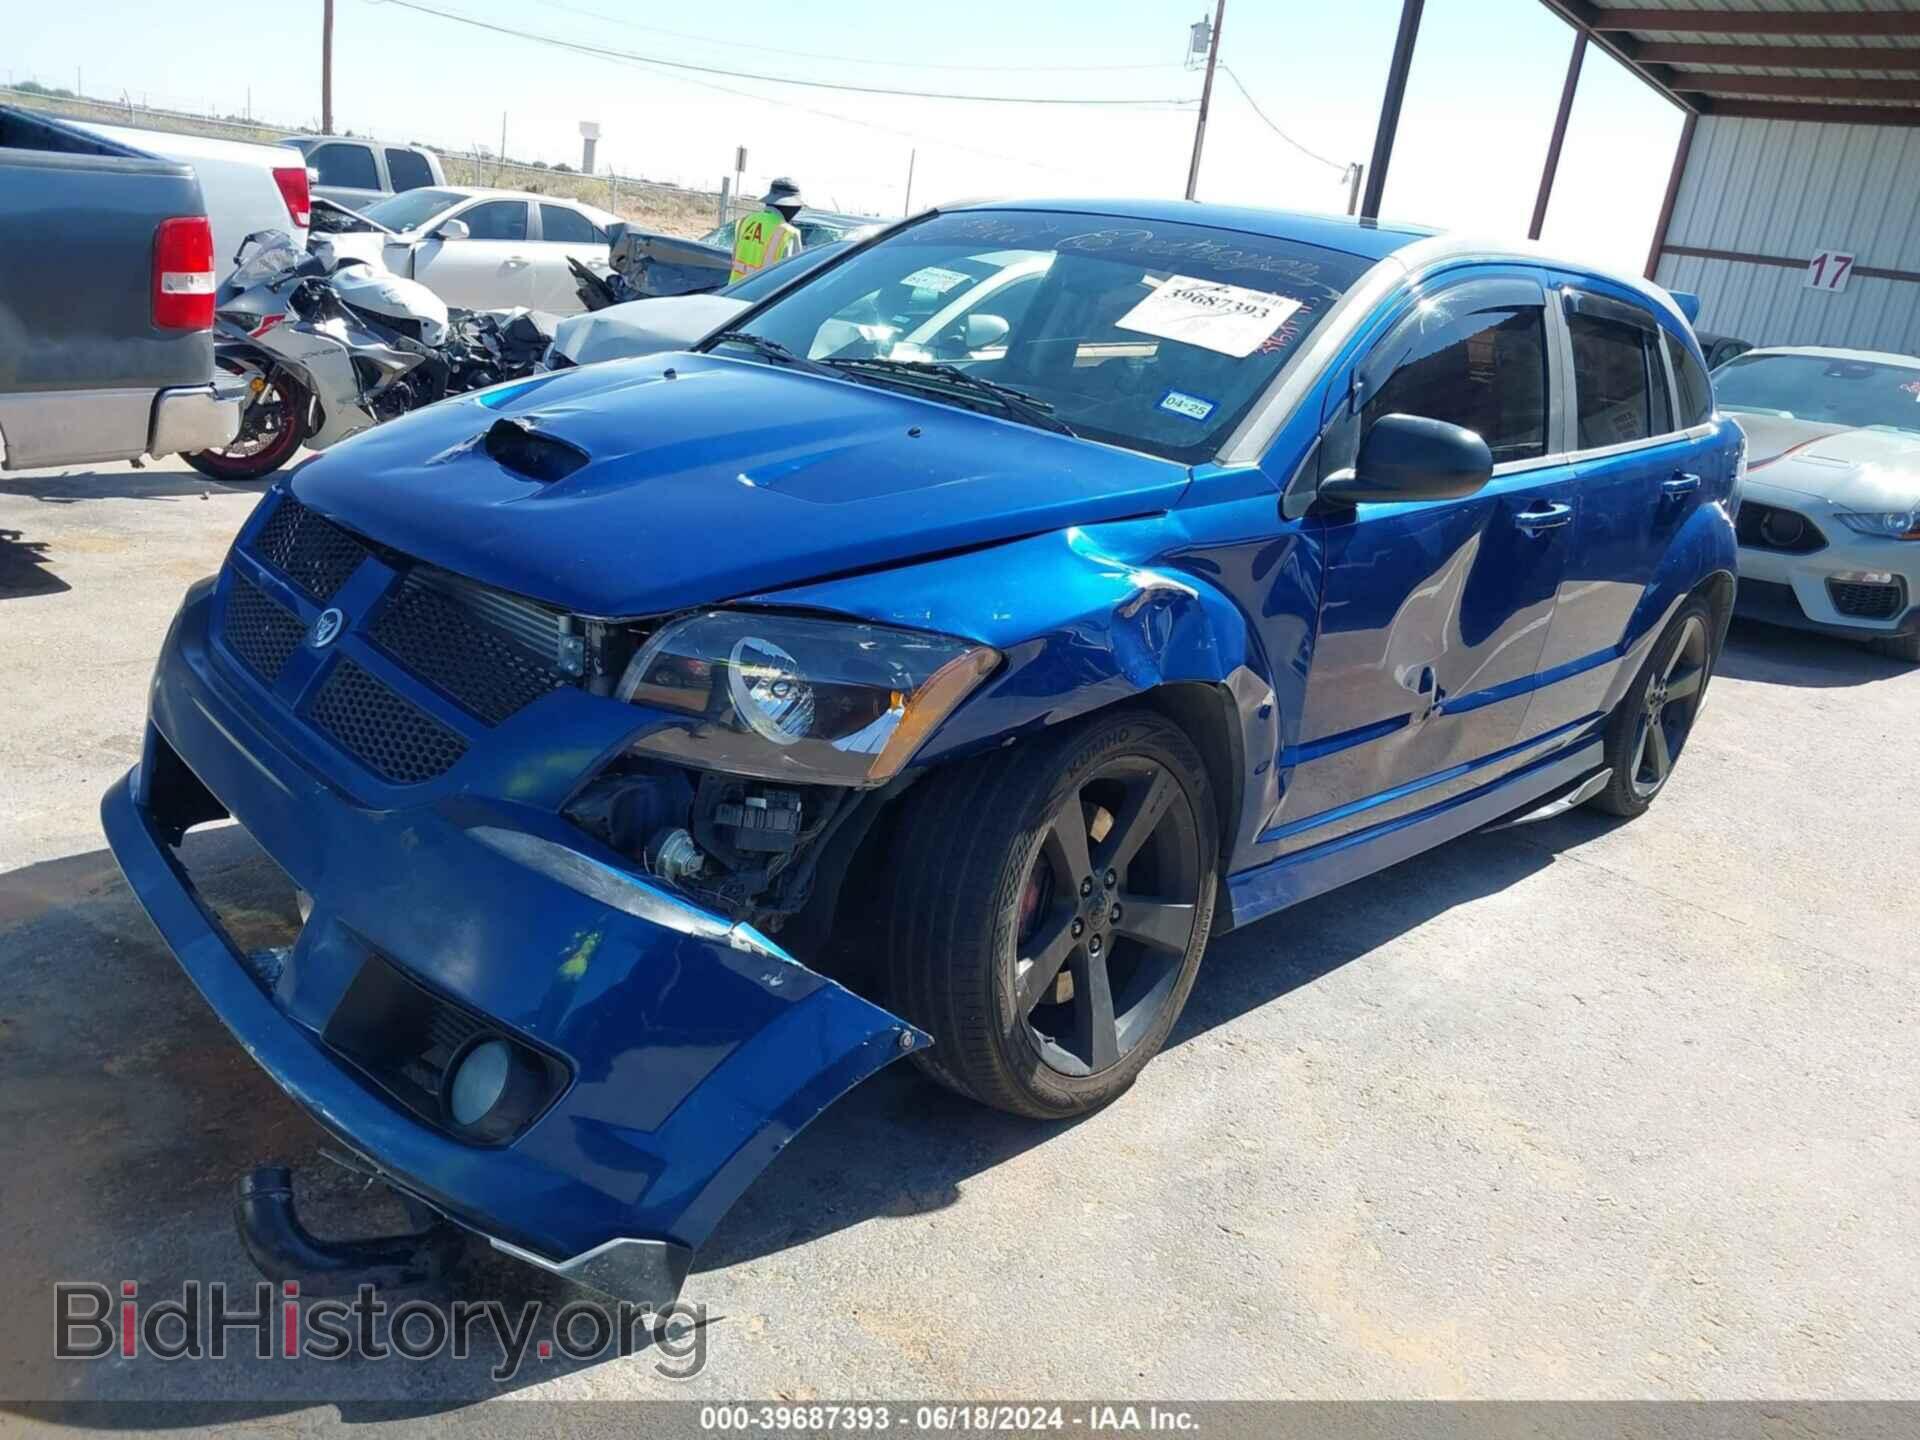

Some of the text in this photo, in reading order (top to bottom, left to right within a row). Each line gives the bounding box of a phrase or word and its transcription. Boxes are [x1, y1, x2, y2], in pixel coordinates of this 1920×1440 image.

[1811, 252, 1853, 289] 17
[1164, 287, 1271, 319] 39687393
[1165, 396, 1208, 416] 04-25
